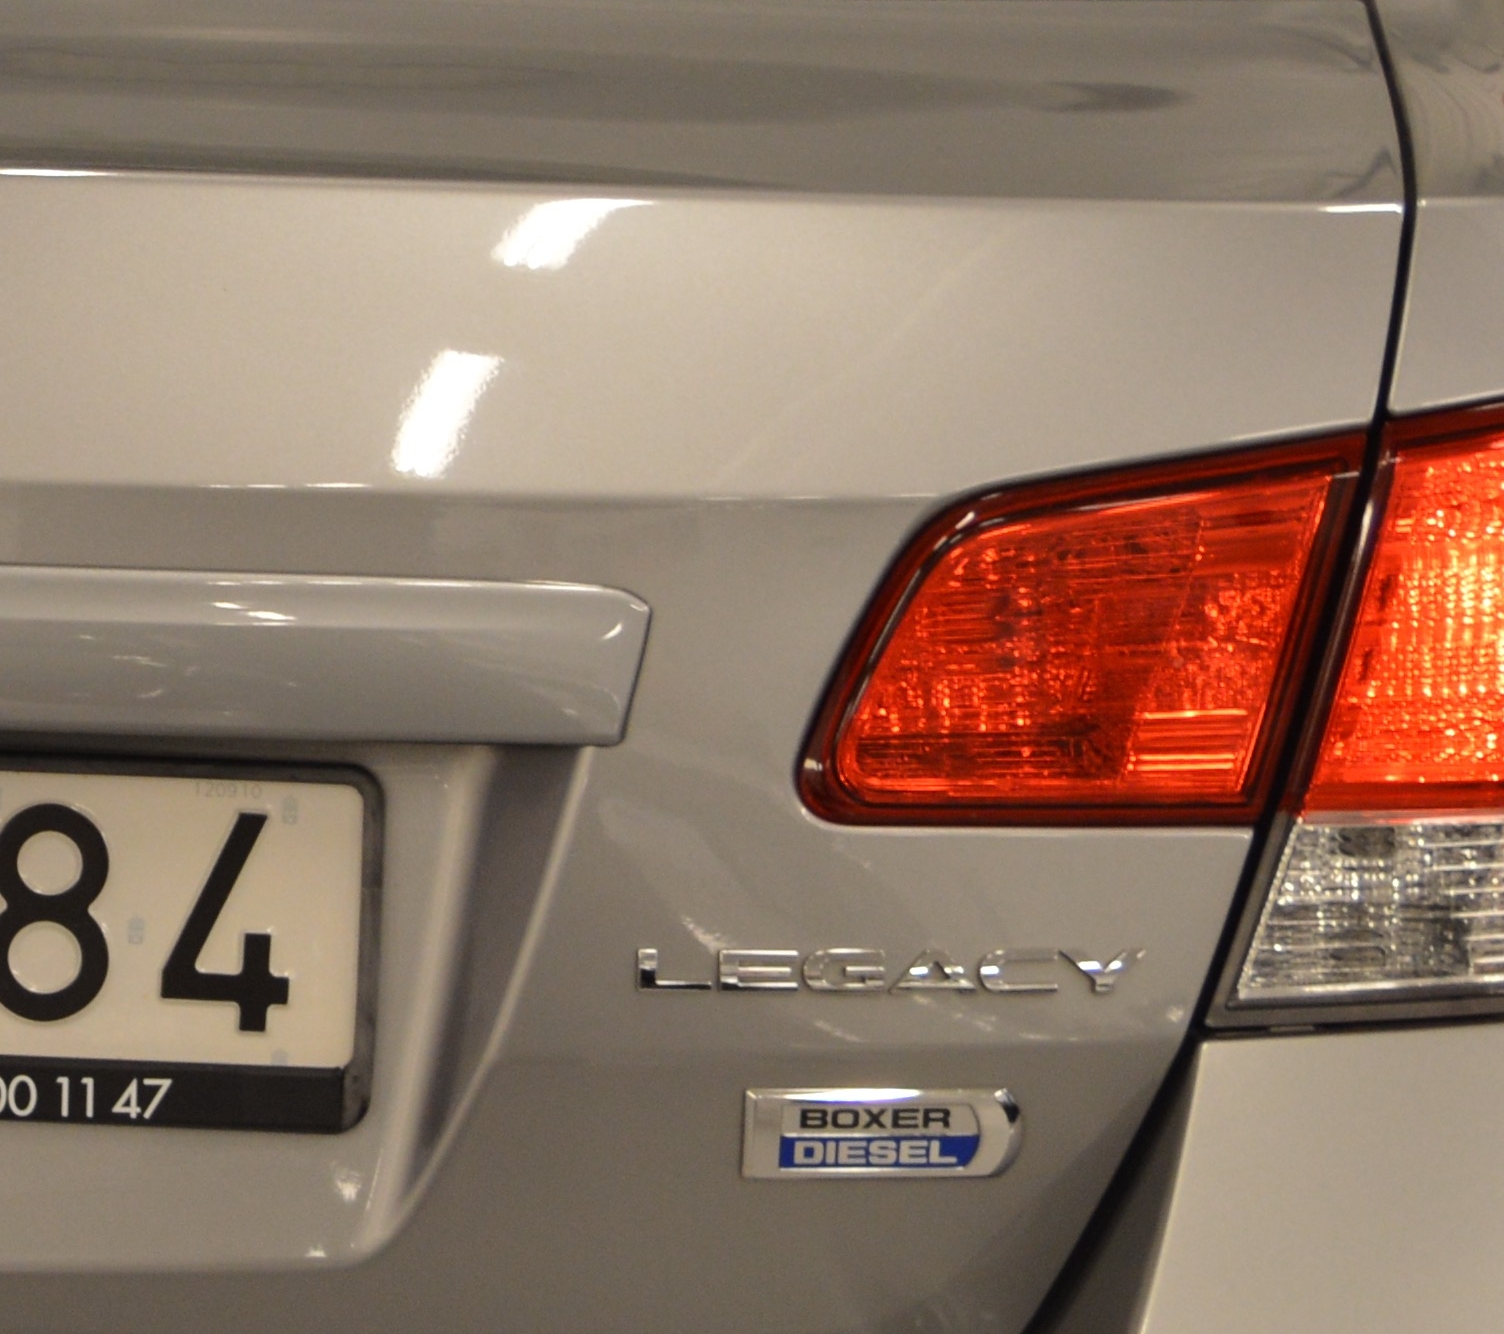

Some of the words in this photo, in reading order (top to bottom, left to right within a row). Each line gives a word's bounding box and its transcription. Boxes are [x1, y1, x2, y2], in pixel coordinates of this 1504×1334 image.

[636, 947, 1147, 994] LEGACY
[55, 1076, 95, 1119] 11
[110, 1076, 174, 1120] 47
[798, 1107, 952, 1131] BOXER
[793, 1138, 958, 1167] DIESEL
